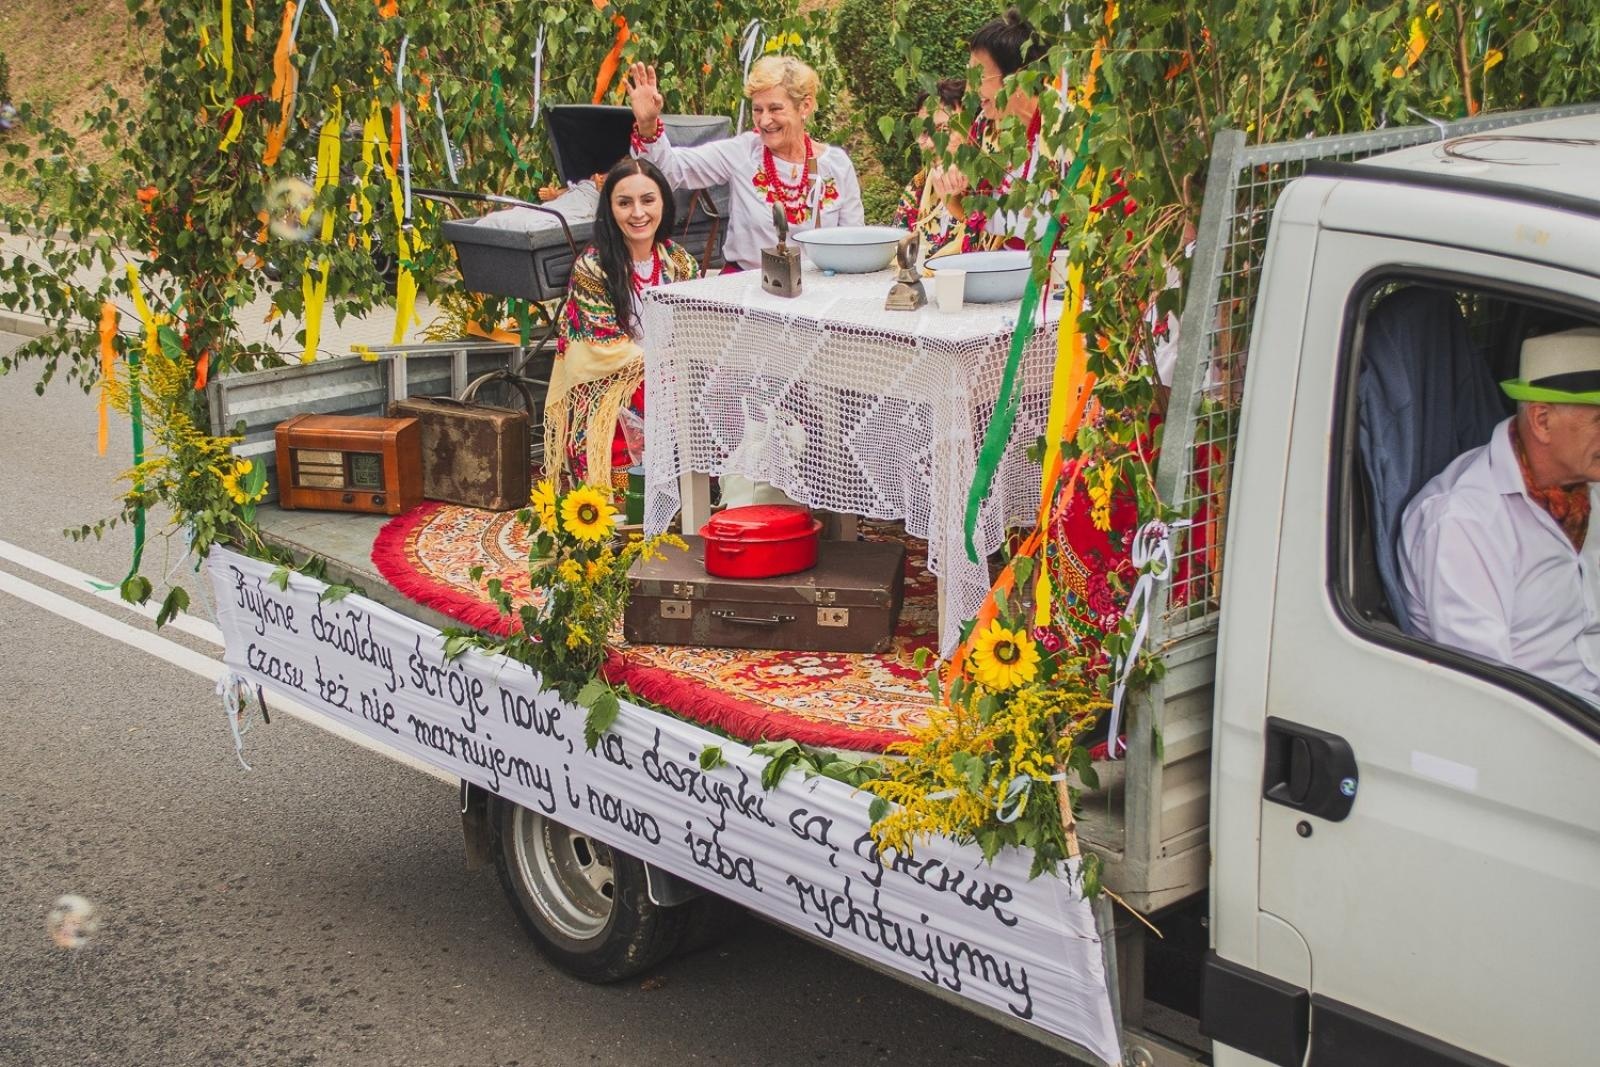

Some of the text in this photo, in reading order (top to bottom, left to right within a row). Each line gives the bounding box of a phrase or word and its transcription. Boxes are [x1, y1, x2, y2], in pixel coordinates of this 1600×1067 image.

[409, 634, 489, 734] stroje
[499, 686, 574, 754] nowe,
[314, 655, 354, 714] też
[360, 688, 400, 734] nie
[408, 713, 556, 814] marnujemy
[563, 763, 580, 809] i
[586, 784, 661, 845] nowo
[684, 820, 763, 892] izba
[785, 874, 1034, 1020] rychtujymy
